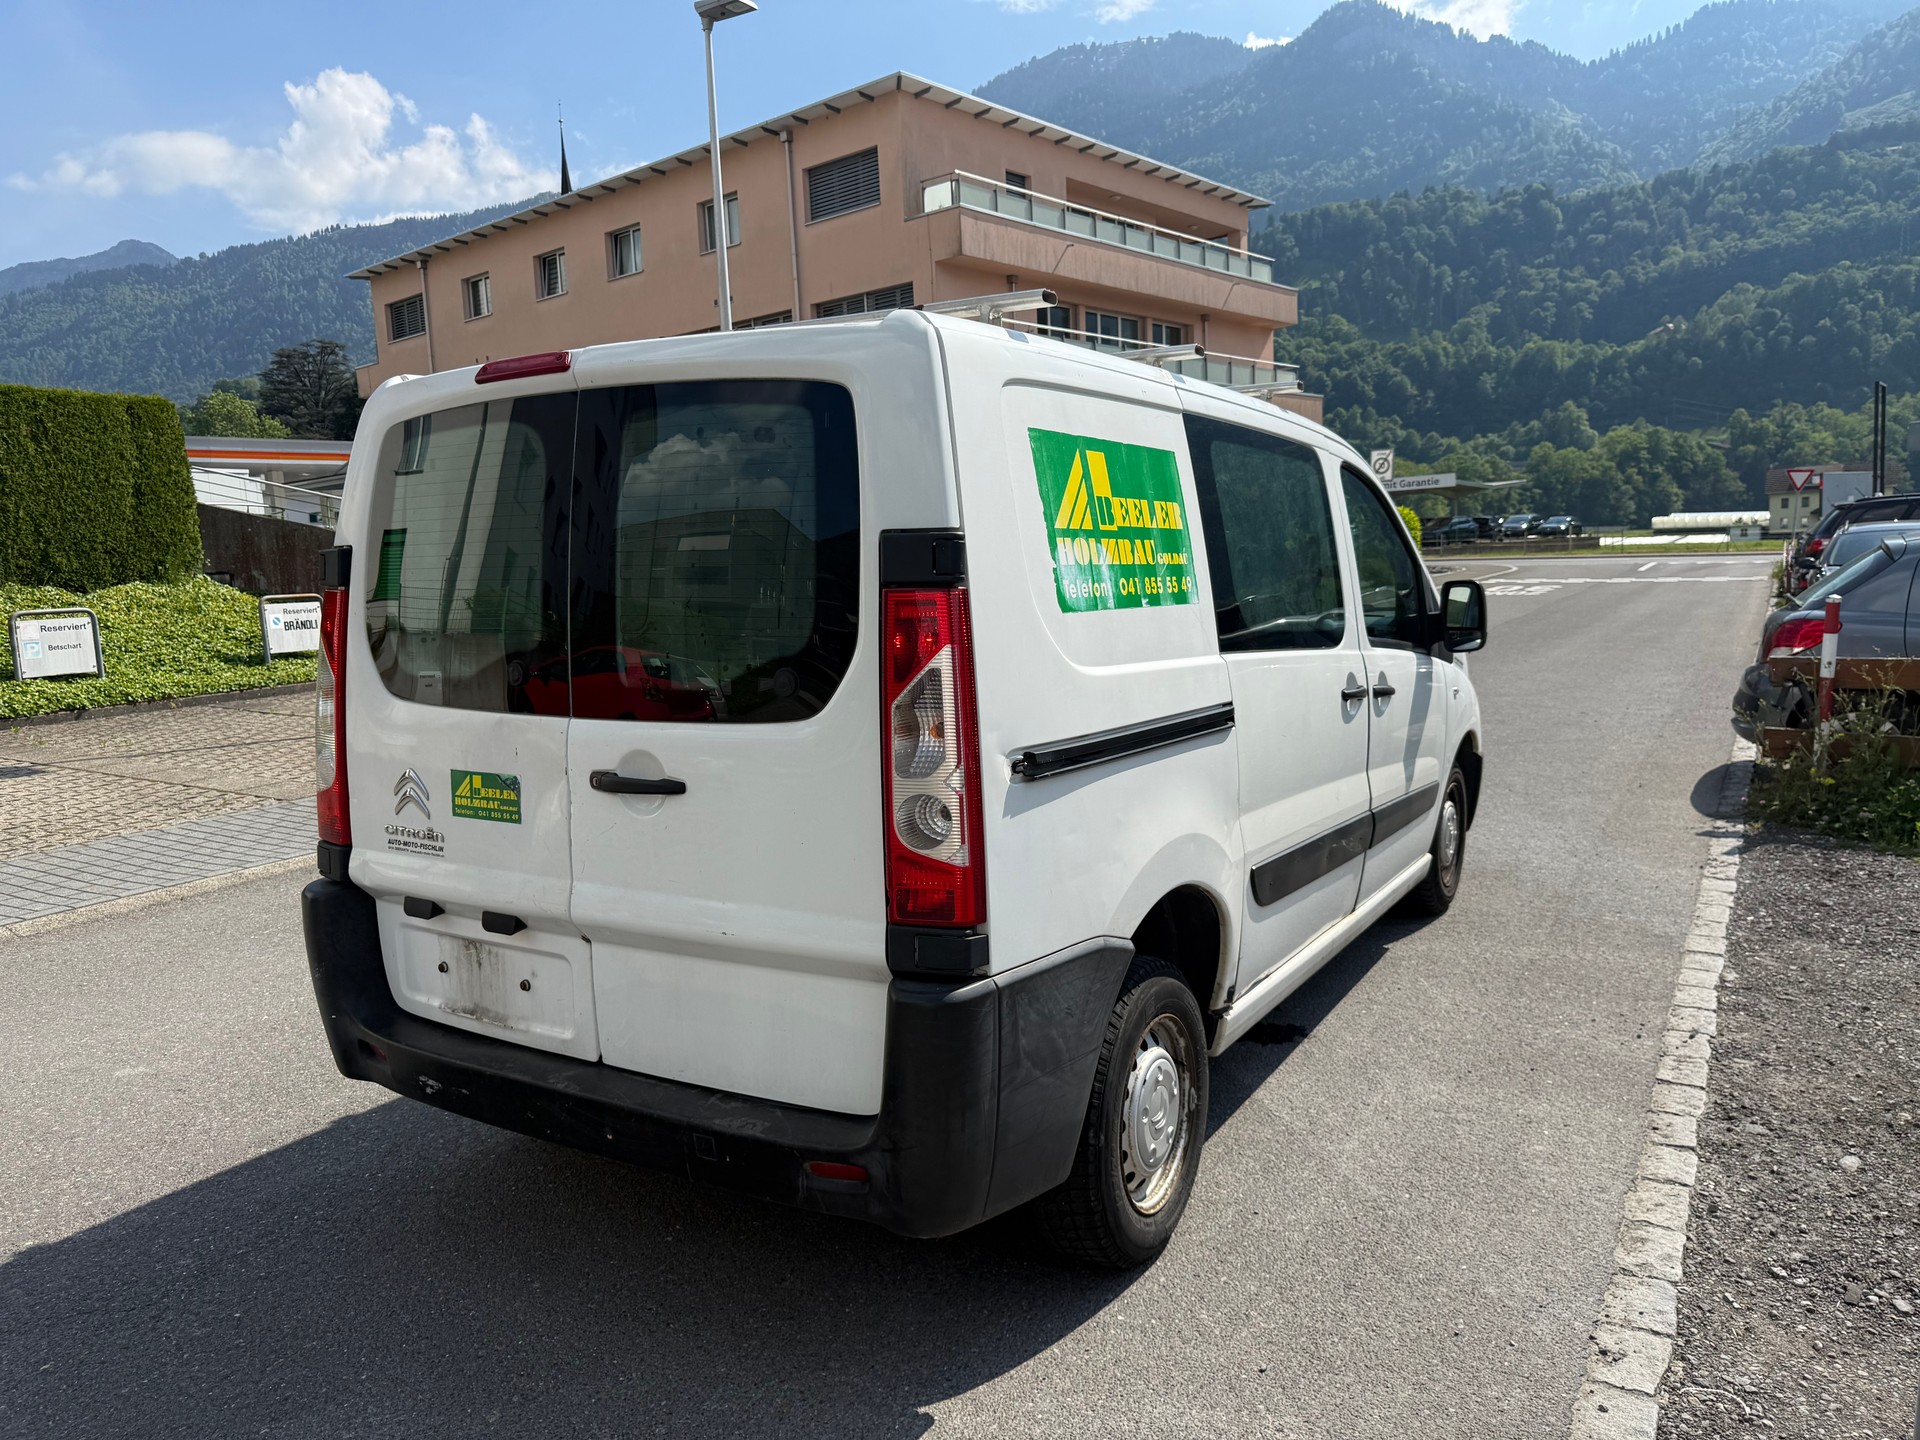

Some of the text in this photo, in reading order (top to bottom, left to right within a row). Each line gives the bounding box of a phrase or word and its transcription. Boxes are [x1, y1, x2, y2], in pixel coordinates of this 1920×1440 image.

[1399, 477, 1440, 488] Garantie
[1095, 495, 1184, 531] BEELER
[1056, 537, 1156, 566] HOLZBAU
[1119, 577, 1141, 596] 041
[1144, 576, 1164, 595] 855
[1166, 576, 1179, 594] 55
[1181, 575, 1192, 593] 49
[283, 607, 318, 615] Reserviert
[40, 623, 87, 632] Reserviert
[283, 618, 319, 631] BRÄNDLI
[48, 643, 82, 651] Betschart
[388, 838, 444, 852] AUTO-MOTO-FISCHLIN
